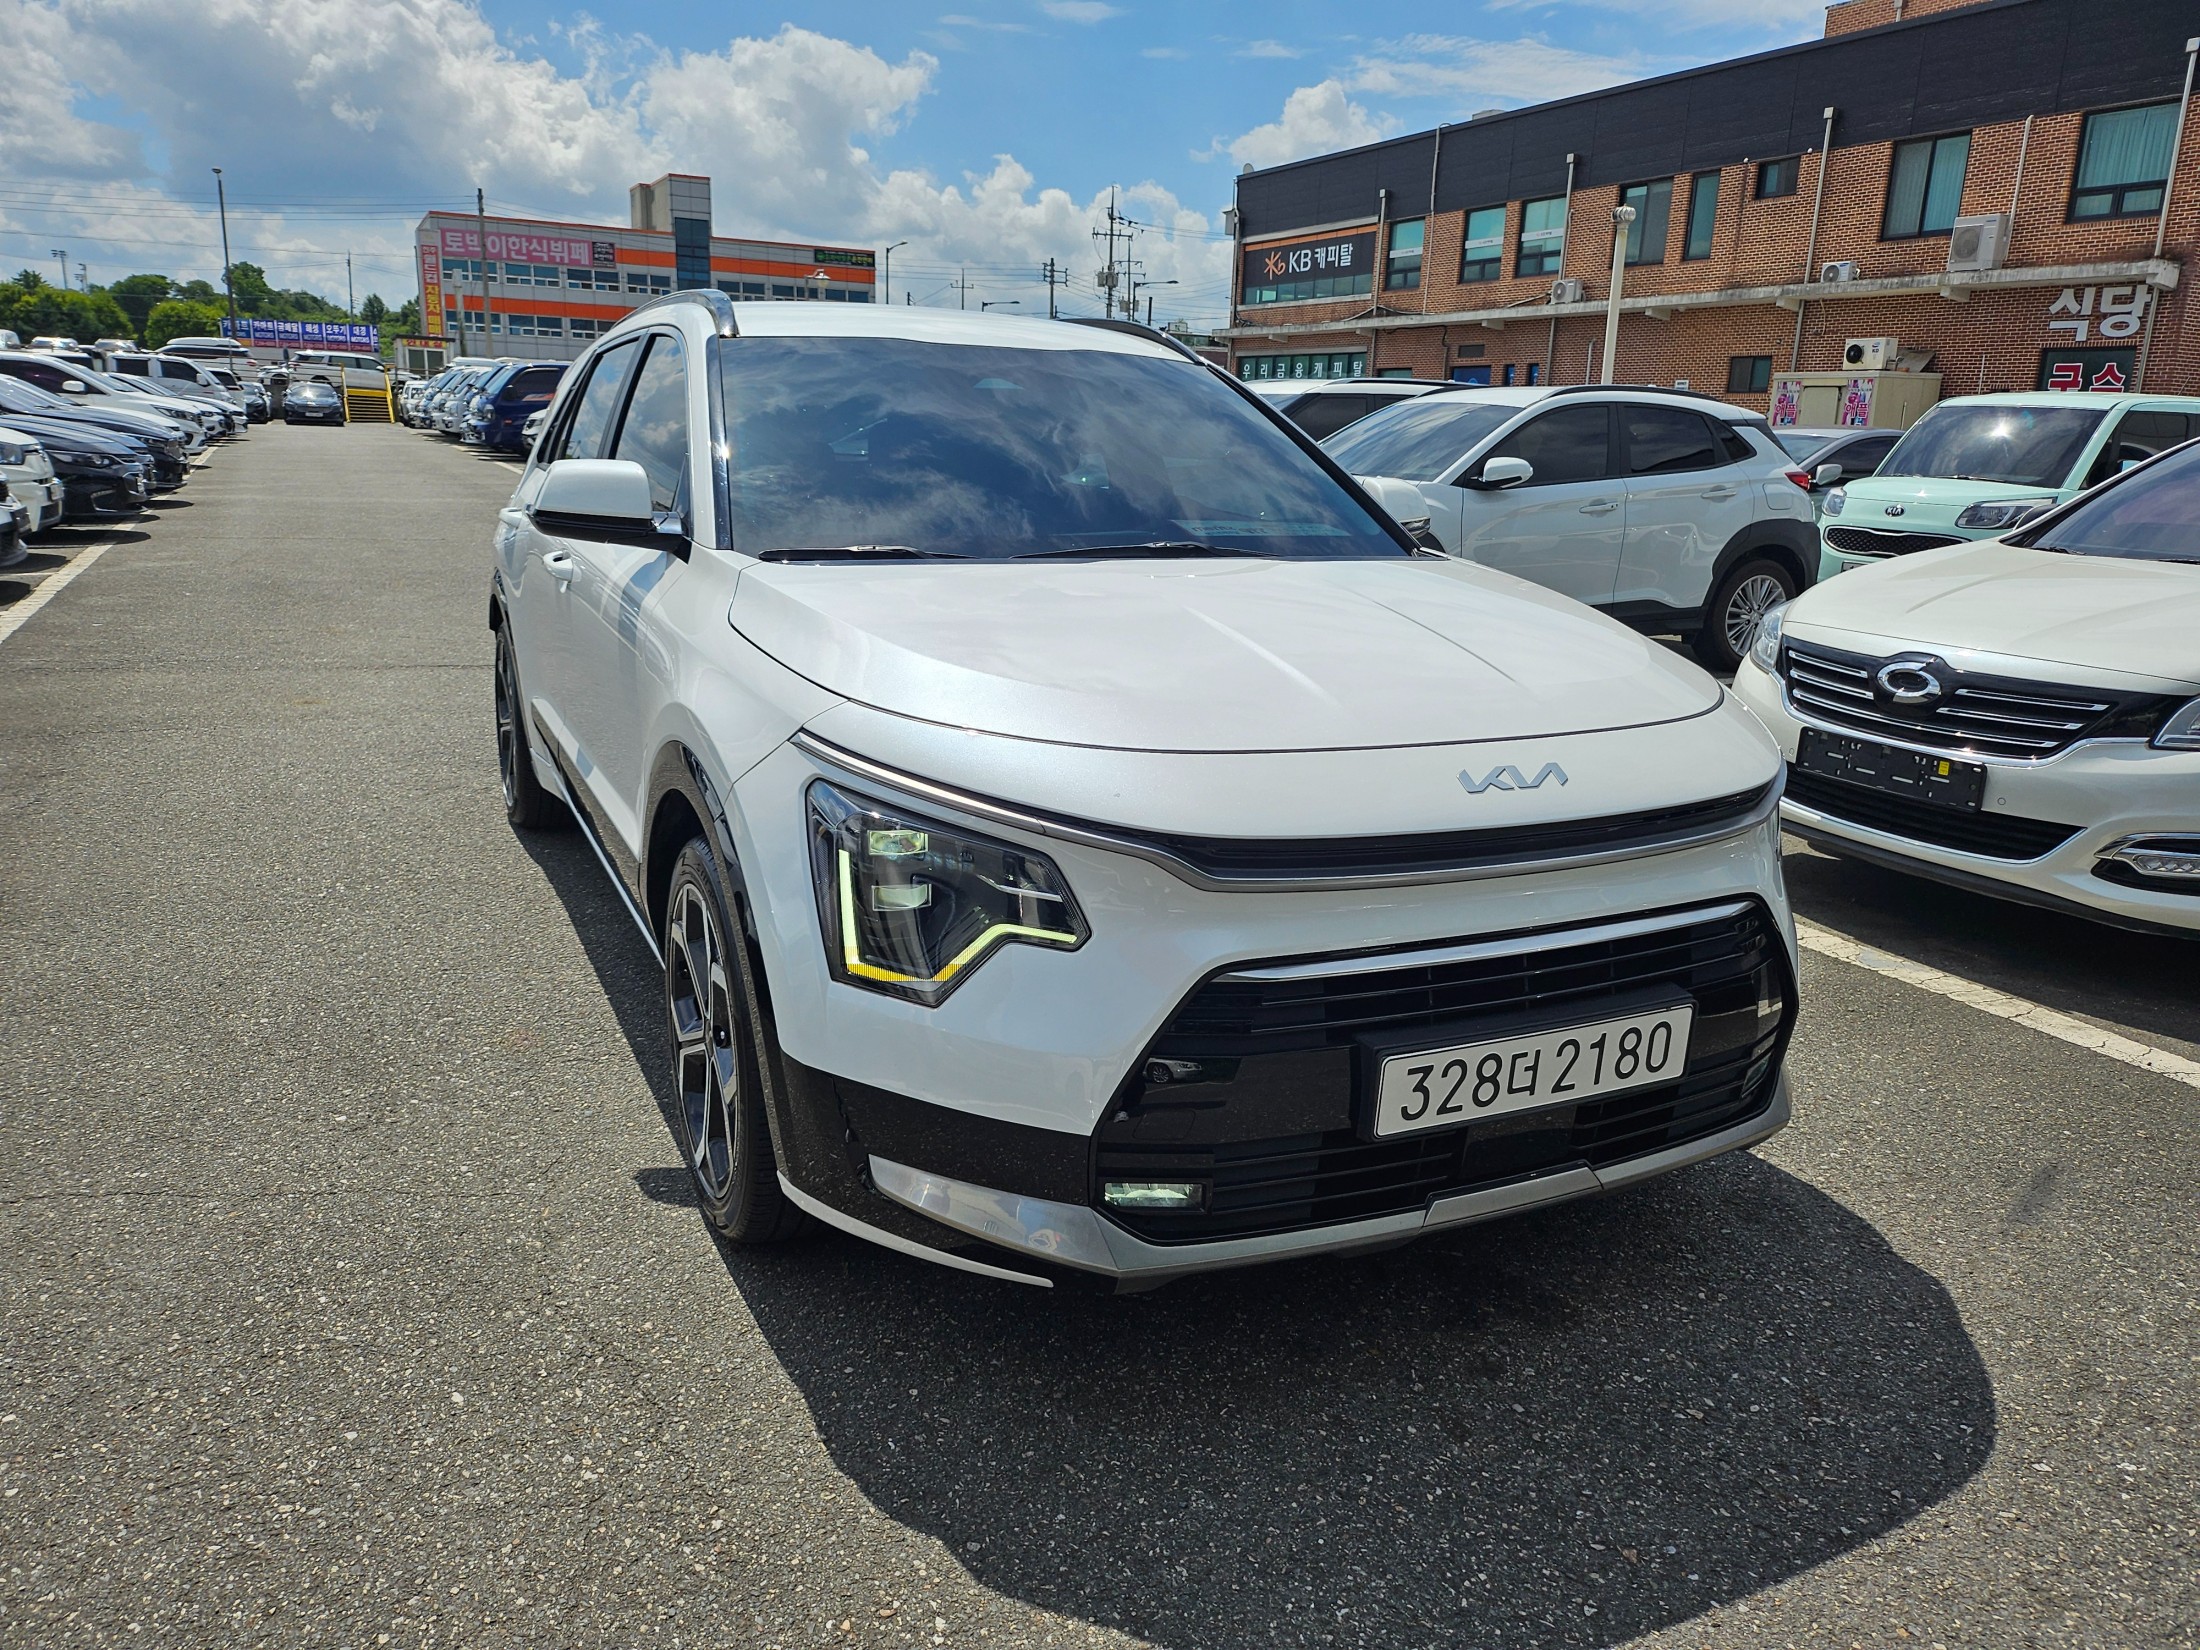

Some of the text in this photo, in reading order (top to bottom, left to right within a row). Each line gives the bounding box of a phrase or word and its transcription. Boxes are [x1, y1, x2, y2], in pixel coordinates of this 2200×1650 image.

[1288, 243, 1353, 273] KB 캐피탈
[2049, 284, 2152, 342] 식당
[326, 325, 347, 335] 오뚜기
[1775, 403, 1797, 418] 애플
[1845, 402, 1869, 418] 애플
[1886, 506, 1902, 515] KIA
[1456, 762, 1568, 794] KIA
[1400, 1021, 1672, 1121] 328더 2180
